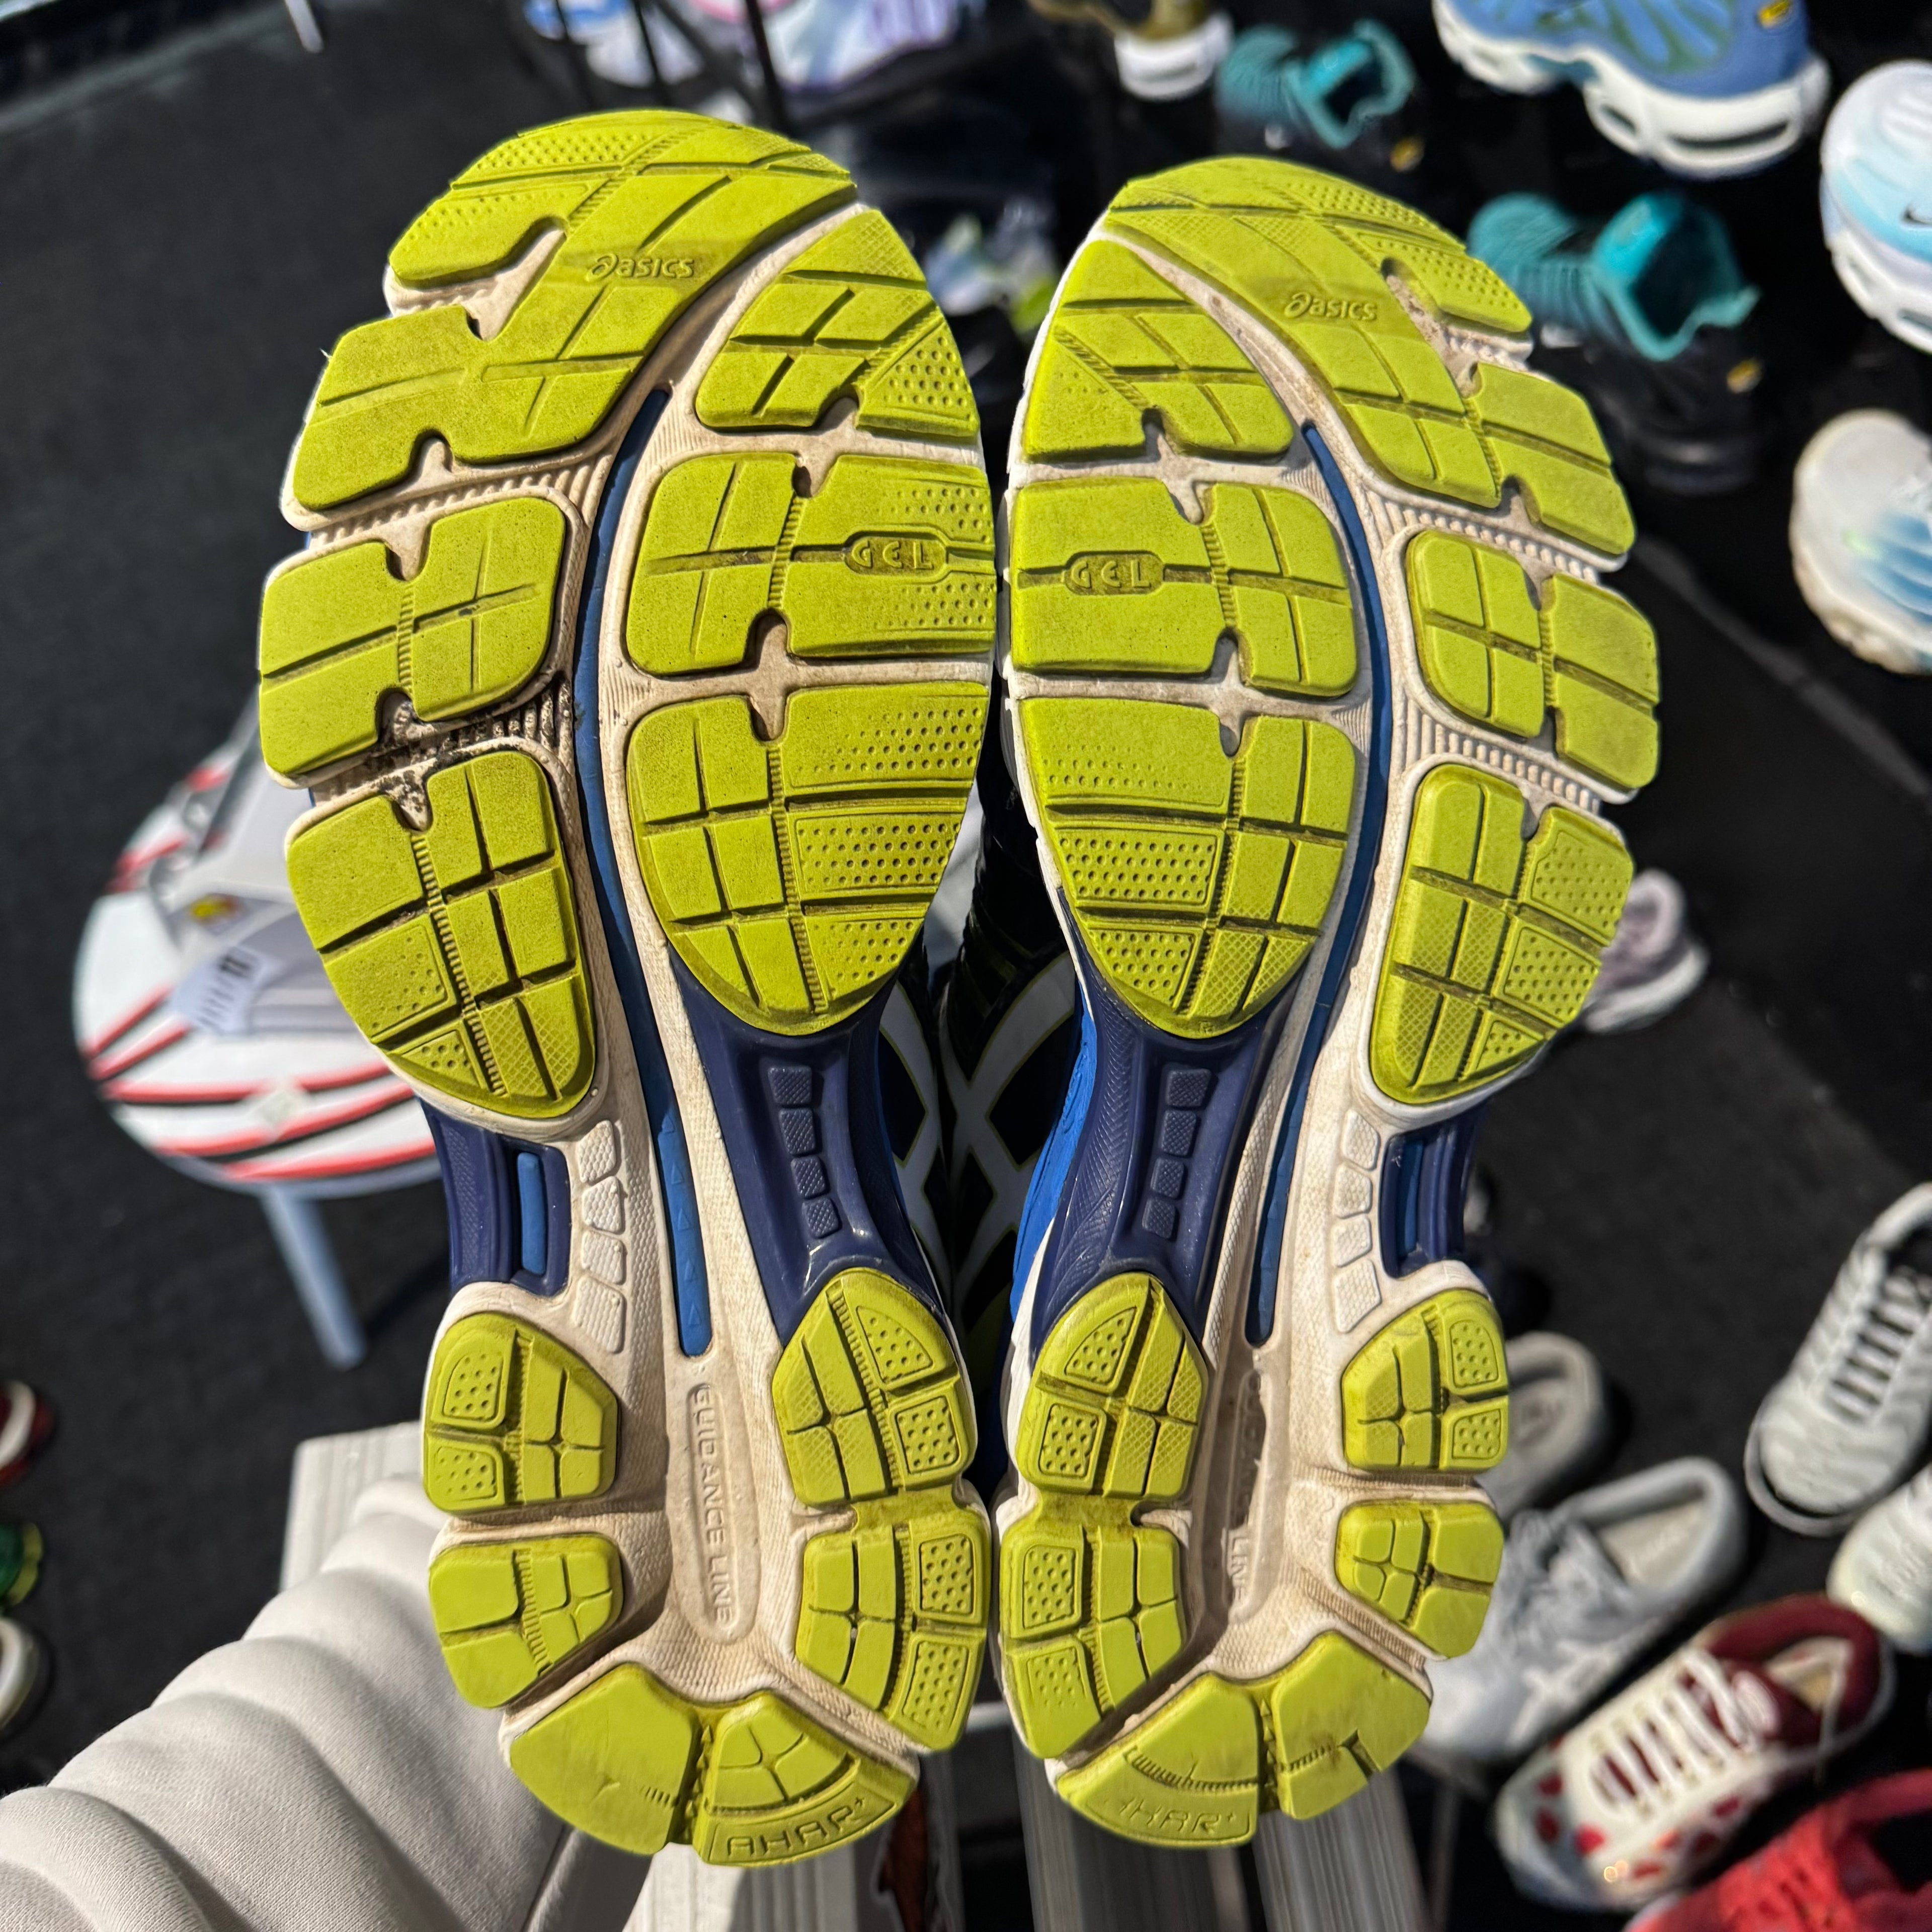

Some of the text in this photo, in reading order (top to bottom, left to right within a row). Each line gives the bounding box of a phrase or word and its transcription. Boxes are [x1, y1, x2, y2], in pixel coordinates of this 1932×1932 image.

[851, 540, 935, 571] GEL
[1071, 559, 1152, 589] GEL
[694, 1386, 733, 1623] GUIDANCE LINE
